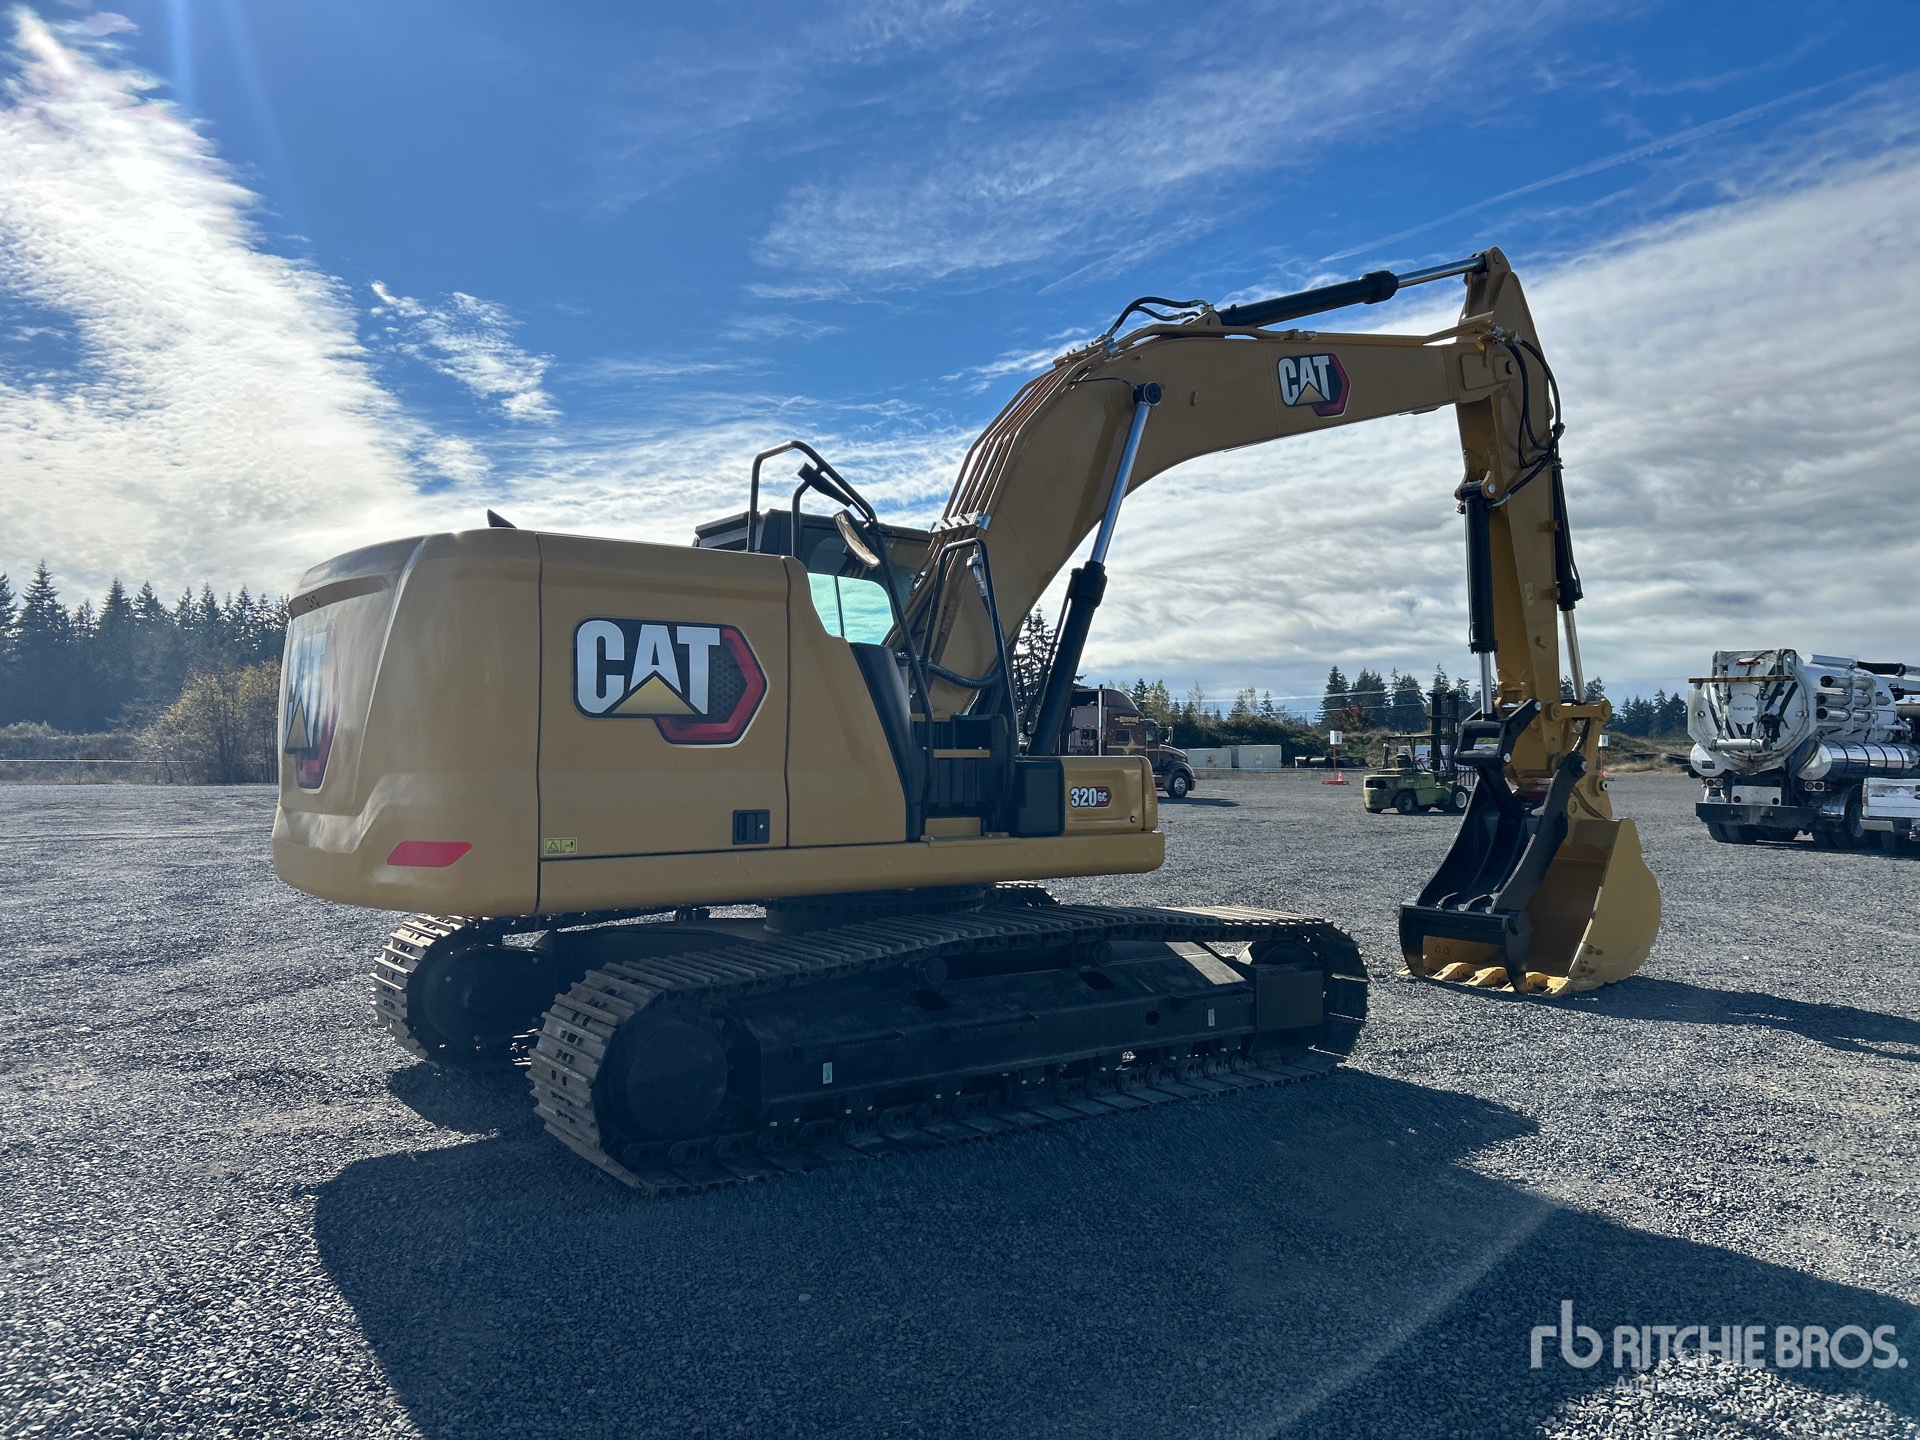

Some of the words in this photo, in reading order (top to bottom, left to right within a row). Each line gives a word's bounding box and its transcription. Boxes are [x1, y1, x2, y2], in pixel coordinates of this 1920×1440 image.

[1278, 355, 1331, 406] CAT
[576, 619, 721, 715] CAT
[1070, 787, 1097, 807] 320
[1097, 791, 1108, 802] GC
